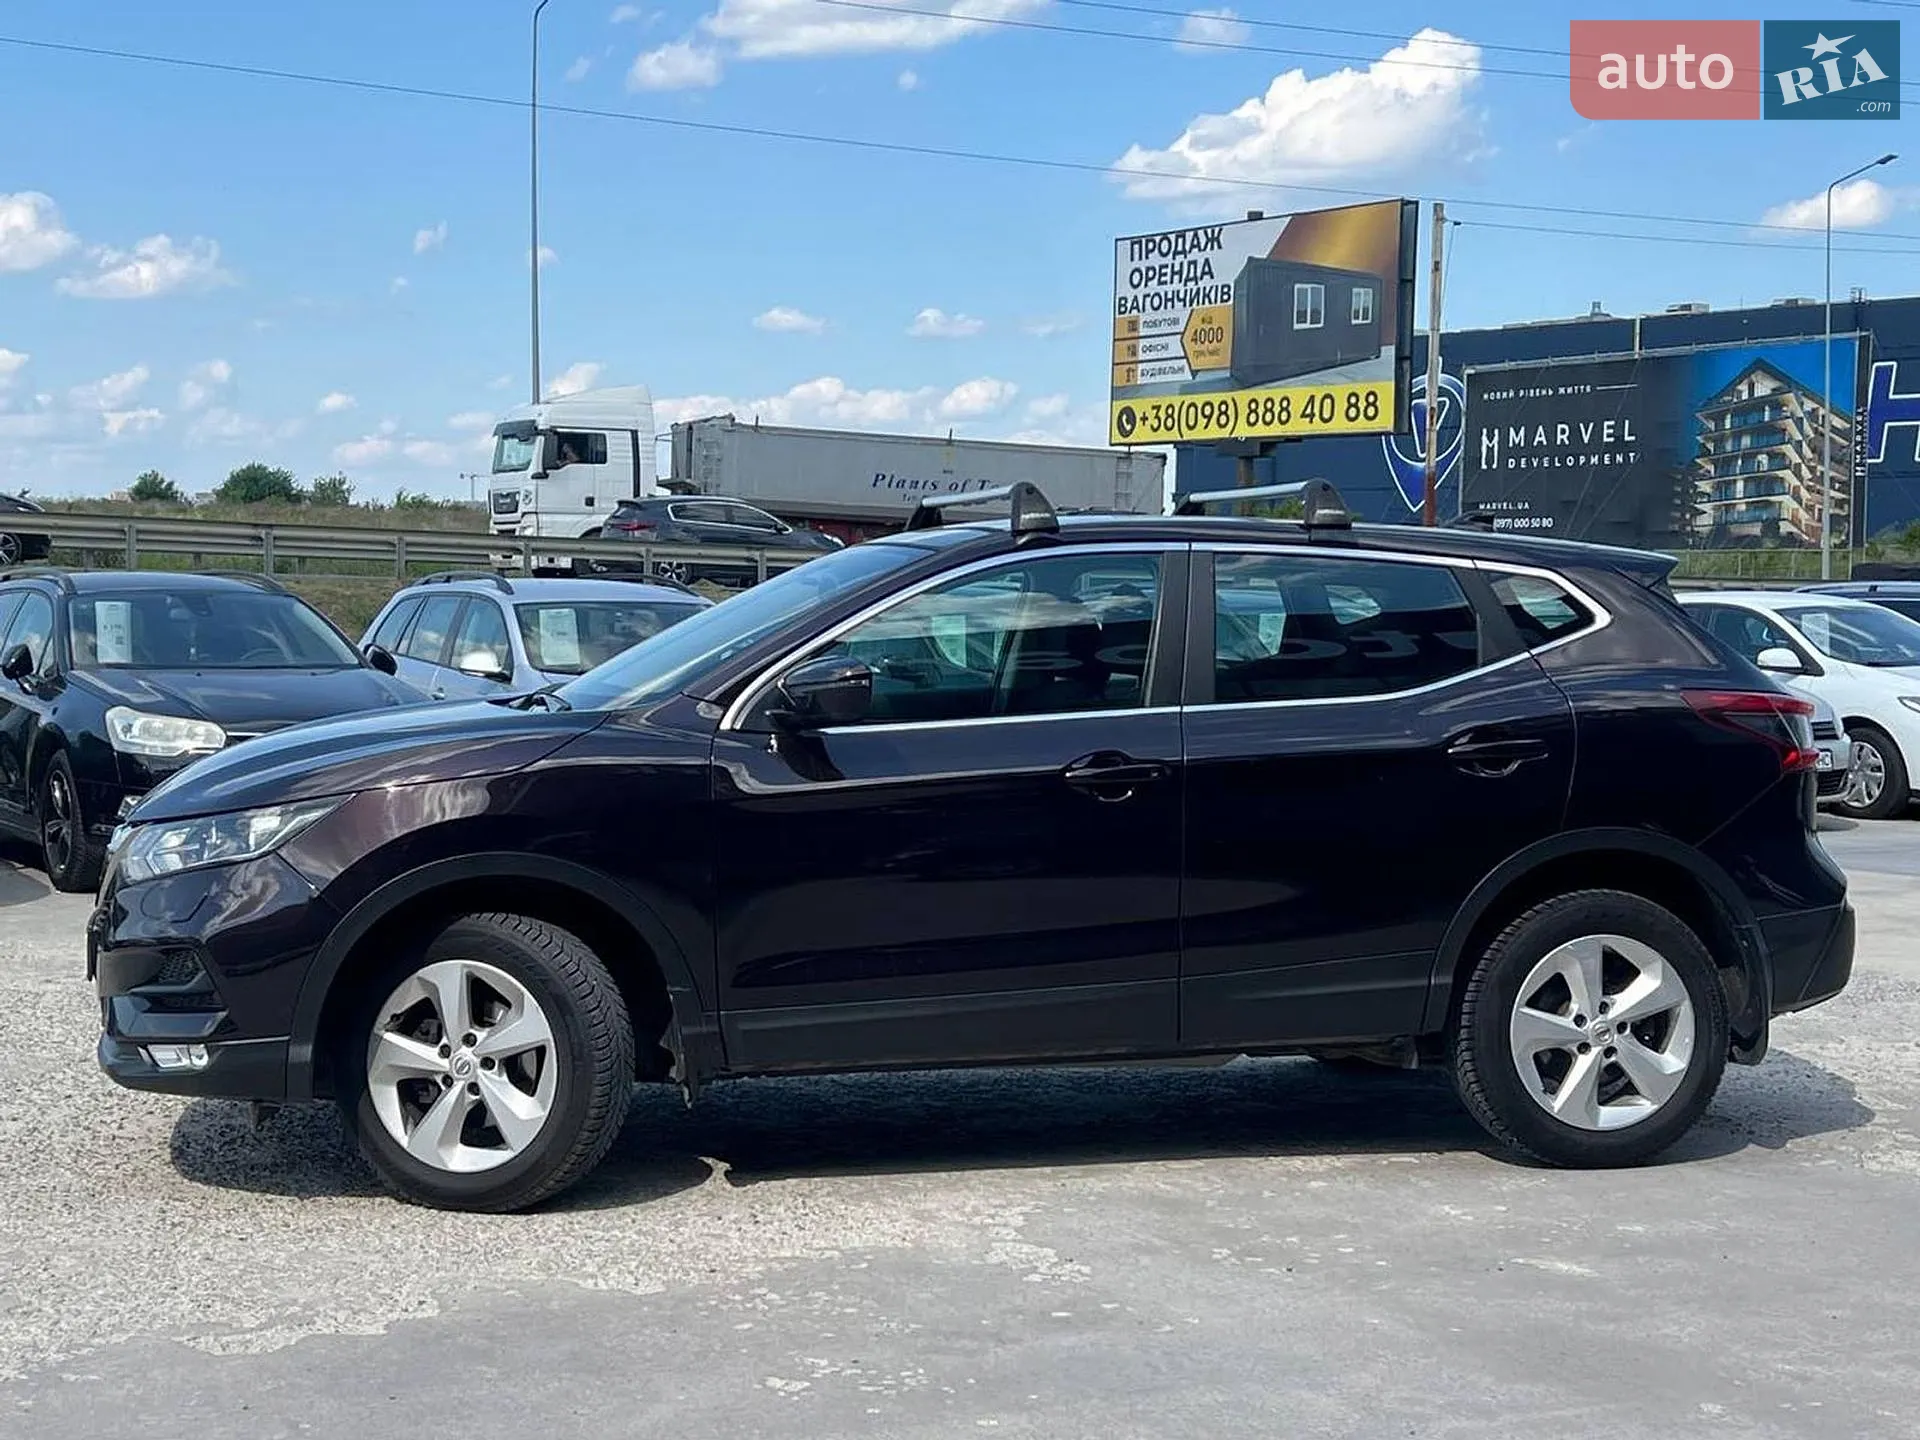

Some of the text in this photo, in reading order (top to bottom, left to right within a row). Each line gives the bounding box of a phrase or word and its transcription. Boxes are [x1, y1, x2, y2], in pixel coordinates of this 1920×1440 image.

[1130, 228, 1223, 262] ПРОДАЖ
[1129, 257, 1214, 290] ОРЕНДА
[1117, 283, 1232, 315] ВАГОНЧИКІВ
[1190, 326, 1224, 346] 4000
[1246, 396, 1292, 426] 888
[1300, 391, 1336, 424] 40
[1345, 390, 1380, 422] 88
[1508, 420, 1636, 447] MARVEL
[1508, 452, 1636, 469] DEVELOPMENT
[873, 473, 938, 491] Plants
[949, 478, 971, 493] of
